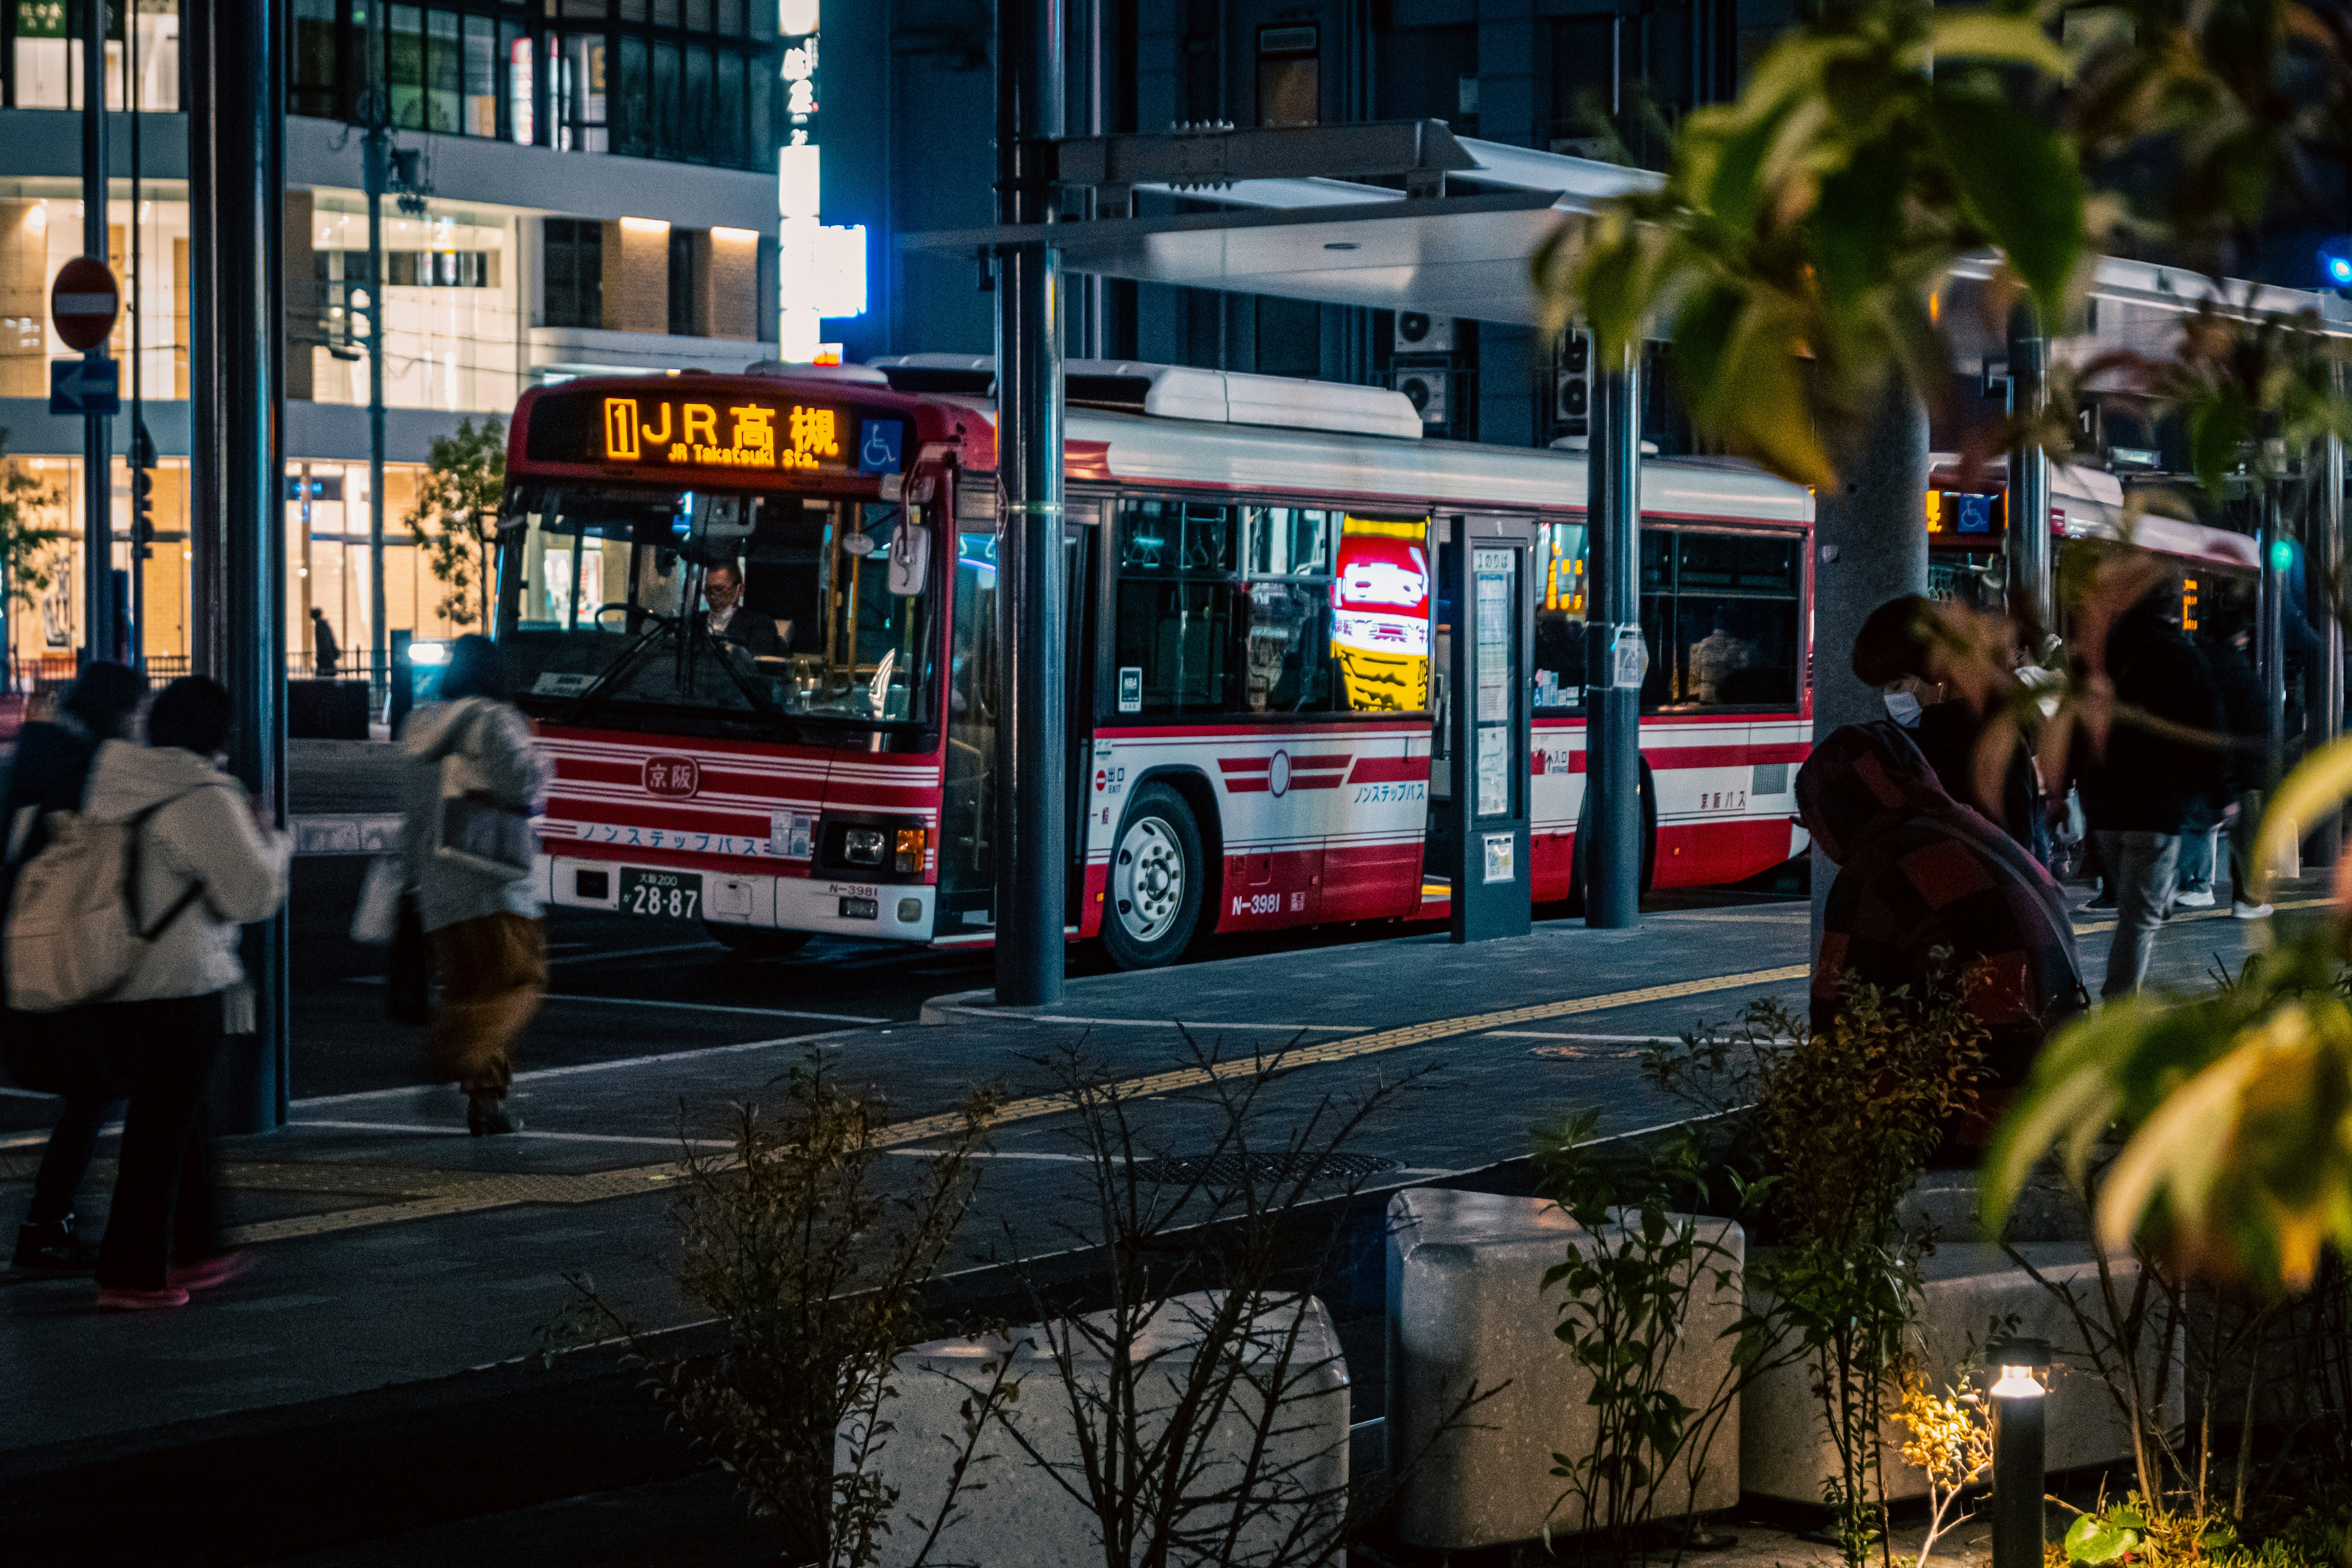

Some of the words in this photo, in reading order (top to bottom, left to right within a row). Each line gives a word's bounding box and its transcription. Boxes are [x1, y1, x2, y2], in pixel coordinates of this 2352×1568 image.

[641, 402, 839, 457] JR高槻
[667, 443, 689, 462] JR
[693, 444, 775, 466] Takatsuki
[782, 449, 819, 469] Sta.
[1554, 750, 1567, 764] 入口
[649, 762, 691, 789] 京阪
[1108, 767, 1124, 782] 出口
[1108, 784, 1121, 794] EXIT
[1354, 783, 1425, 804] ノンステップバス
[1701, 790, 1745, 810] 京阪バス
[583, 825, 757, 856] ノンステップバス
[658, 875, 678, 886] 200
[829, 883, 877, 897] N-3981
[633, 884, 698, 918] 28-87
[1232, 893, 1280, 916] N-3981
